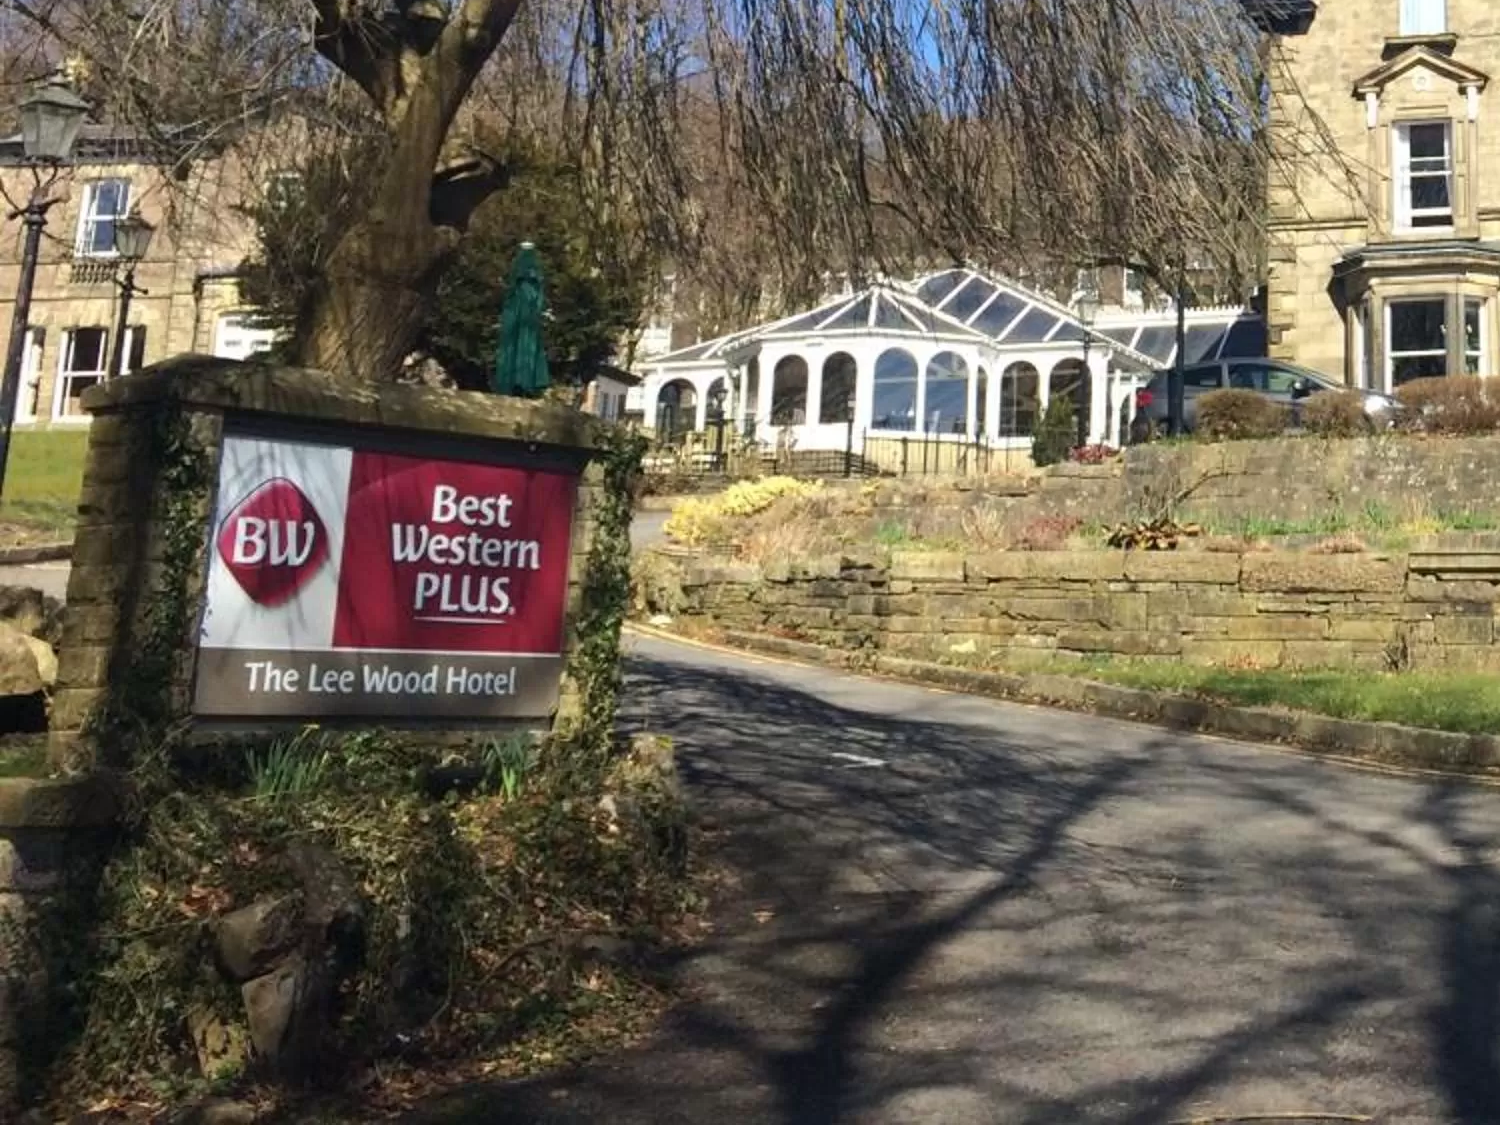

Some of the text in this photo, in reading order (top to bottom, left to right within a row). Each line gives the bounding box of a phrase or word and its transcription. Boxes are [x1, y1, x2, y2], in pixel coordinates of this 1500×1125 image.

[431, 484, 513, 527] Best
[232, 516, 316, 566] BW
[391, 522, 541, 570] Western
[245, 661, 517, 695] The Lee Wood Hotel
